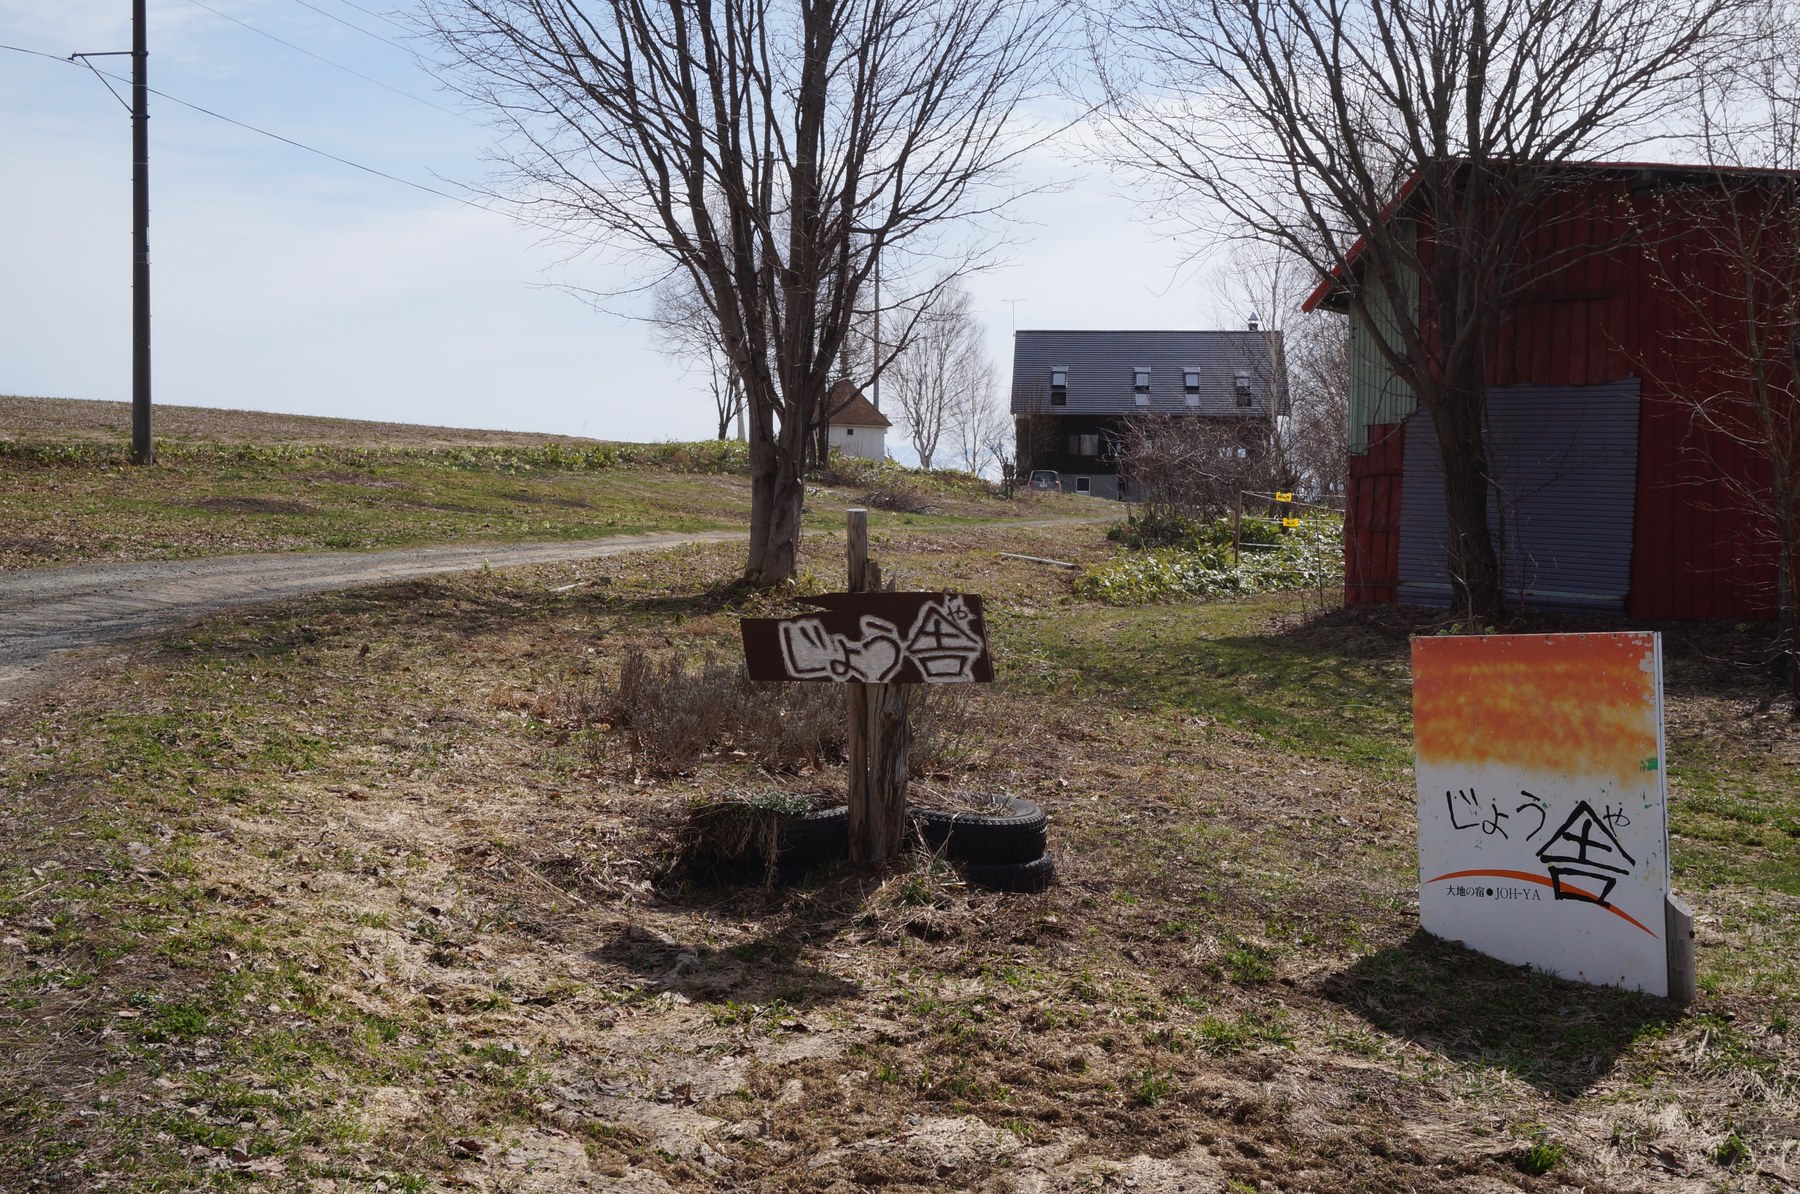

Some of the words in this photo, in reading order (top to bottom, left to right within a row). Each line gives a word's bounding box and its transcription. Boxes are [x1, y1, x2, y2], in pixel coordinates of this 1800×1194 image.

[1446, 884, 1485, 898] 大地の宿
[1494, 887, 1541, 901] JOH-YA
